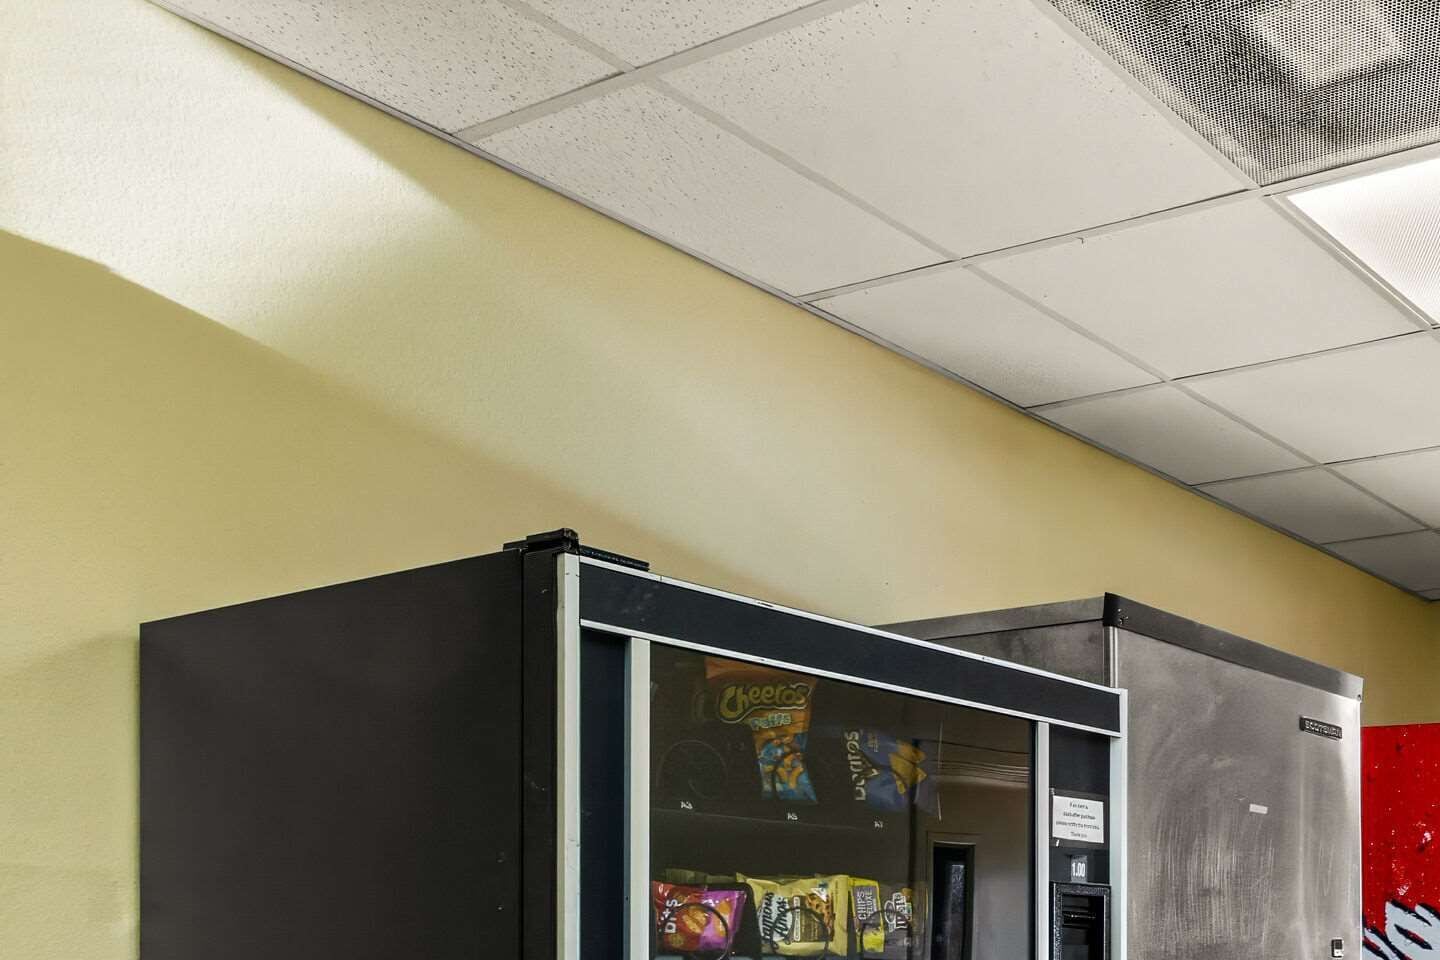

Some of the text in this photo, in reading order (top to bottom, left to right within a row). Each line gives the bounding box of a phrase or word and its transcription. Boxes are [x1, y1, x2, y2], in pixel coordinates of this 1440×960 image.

[721, 686, 806, 719] Cheetos
[1071, 862, 1086, 877] 1.00
[857, 891, 867, 920] CHIPS
